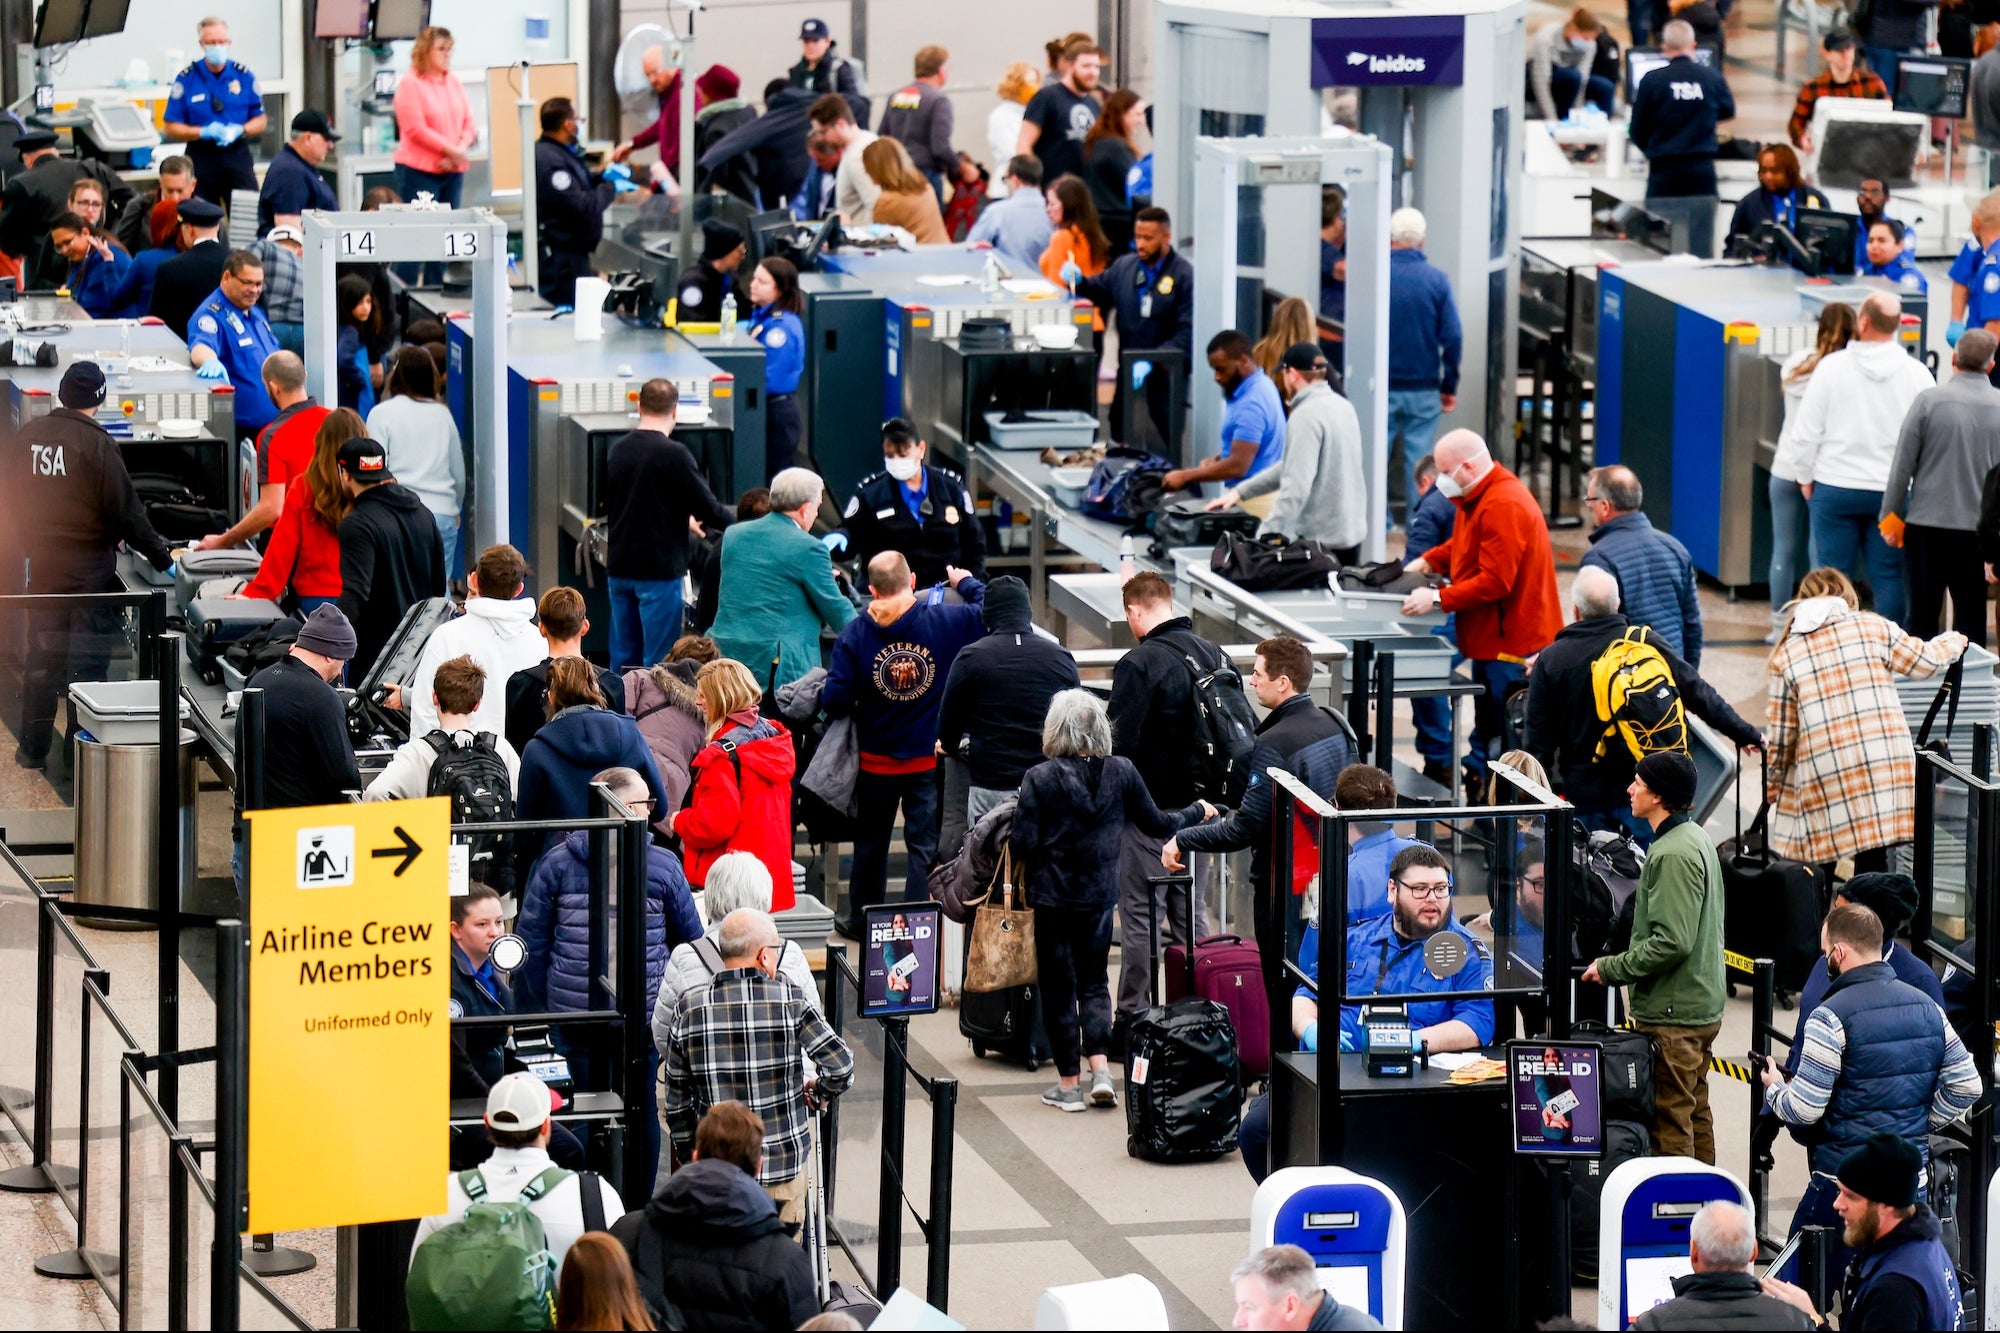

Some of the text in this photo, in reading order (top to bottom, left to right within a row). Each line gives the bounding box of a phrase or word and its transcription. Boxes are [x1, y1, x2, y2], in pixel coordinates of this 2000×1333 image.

[1369, 54, 1426, 73] leidos
[1669, 81, 1704, 100] TSA
[342, 231, 375, 255] 14
[446, 232, 477, 257] 13
[31, 444, 67, 476] TSA
[875, 642, 930, 662] VETERAN
[260, 921, 433, 954] Airline Crew
[871, 926, 932, 942] REAL ID
[299, 954, 433, 985] Members
[304, 1008, 433, 1033] Uniformed Only
[1519, 1061, 1571, 1076] REAL
[1572, 1062, 1592, 1076] ID
[1627, 1062, 1637, 1089] THULE
